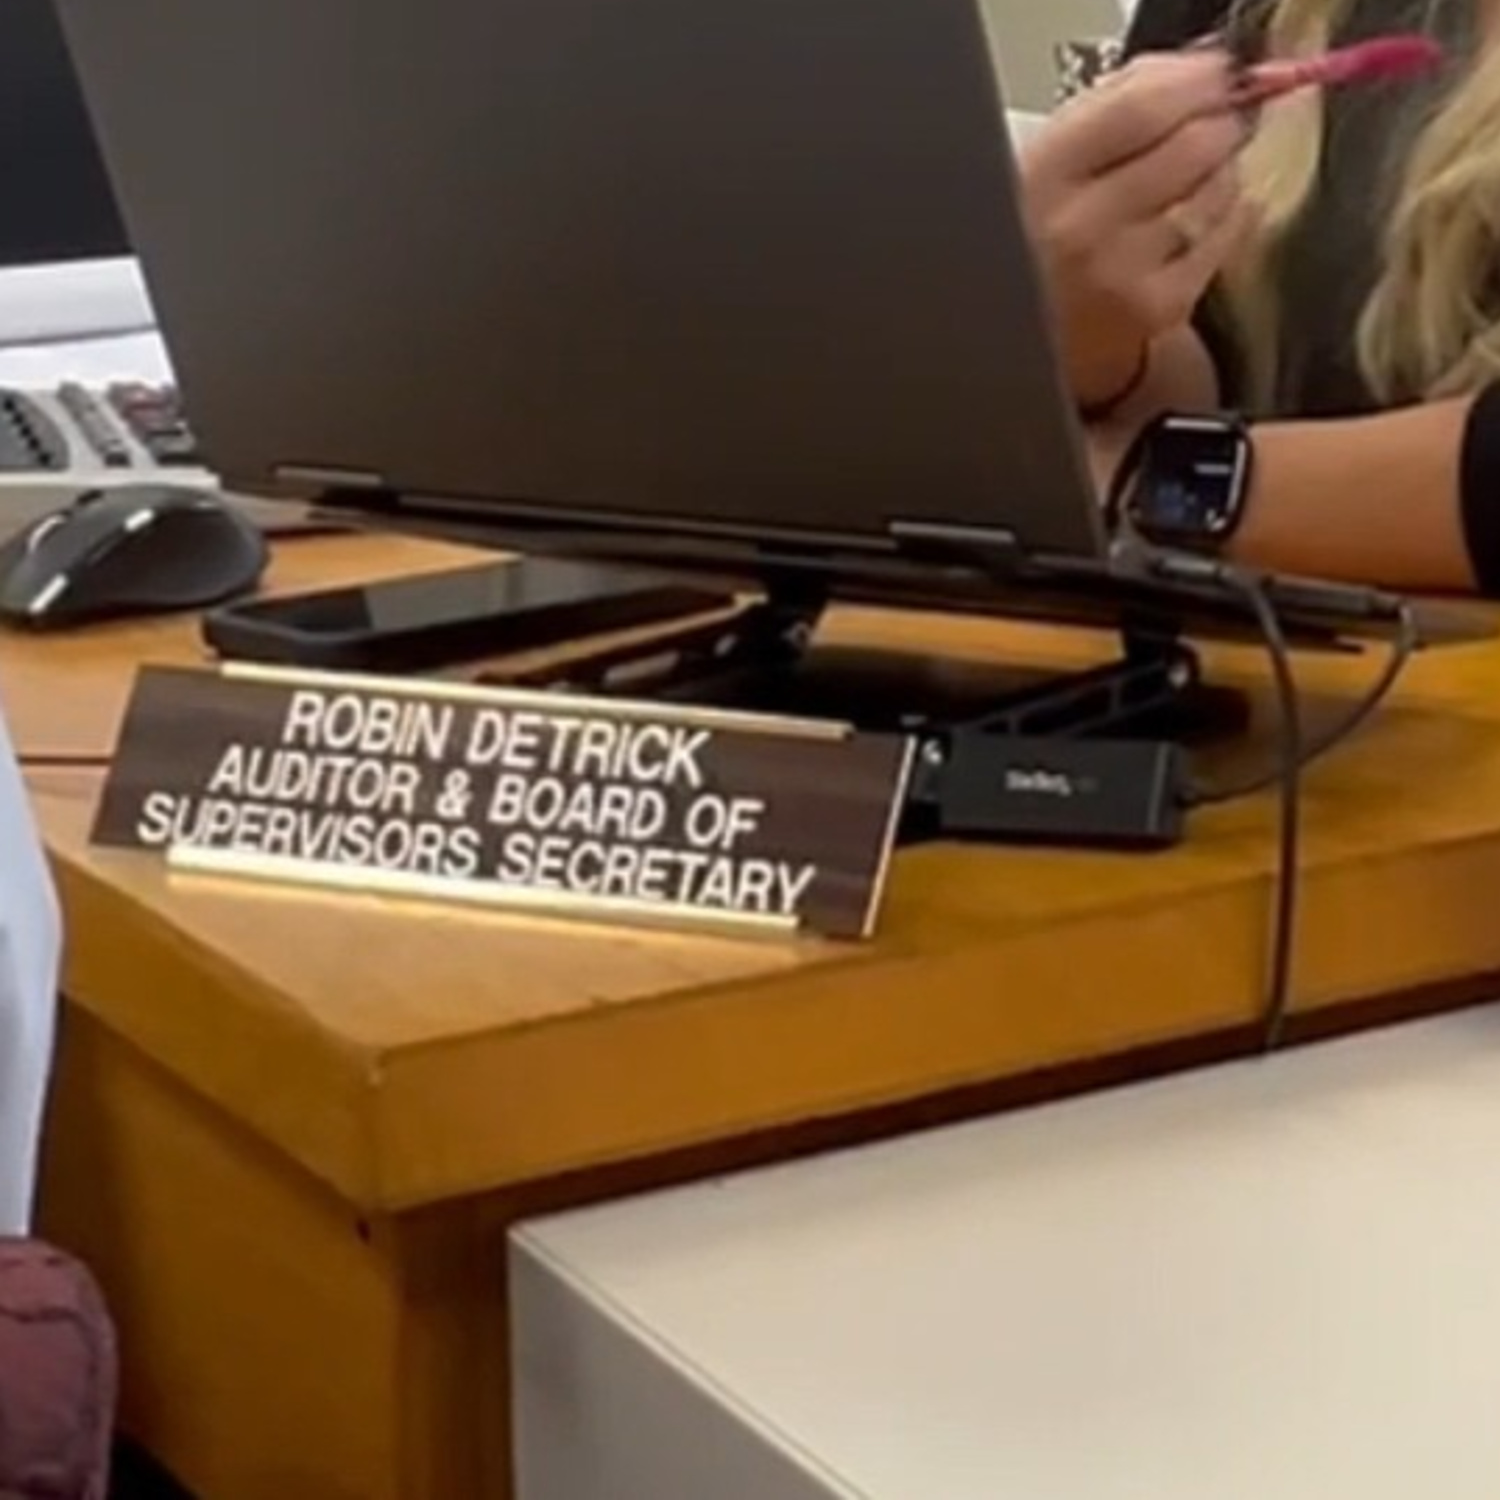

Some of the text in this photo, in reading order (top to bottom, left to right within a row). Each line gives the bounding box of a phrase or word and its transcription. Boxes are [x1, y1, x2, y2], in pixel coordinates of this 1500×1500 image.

[282, 690, 712, 788] ROBIN DETRICK
[206, 744, 765, 850] AUDITOR & BOARD OF
[137, 792, 816, 915] SUPERVISORS SECRETARY
